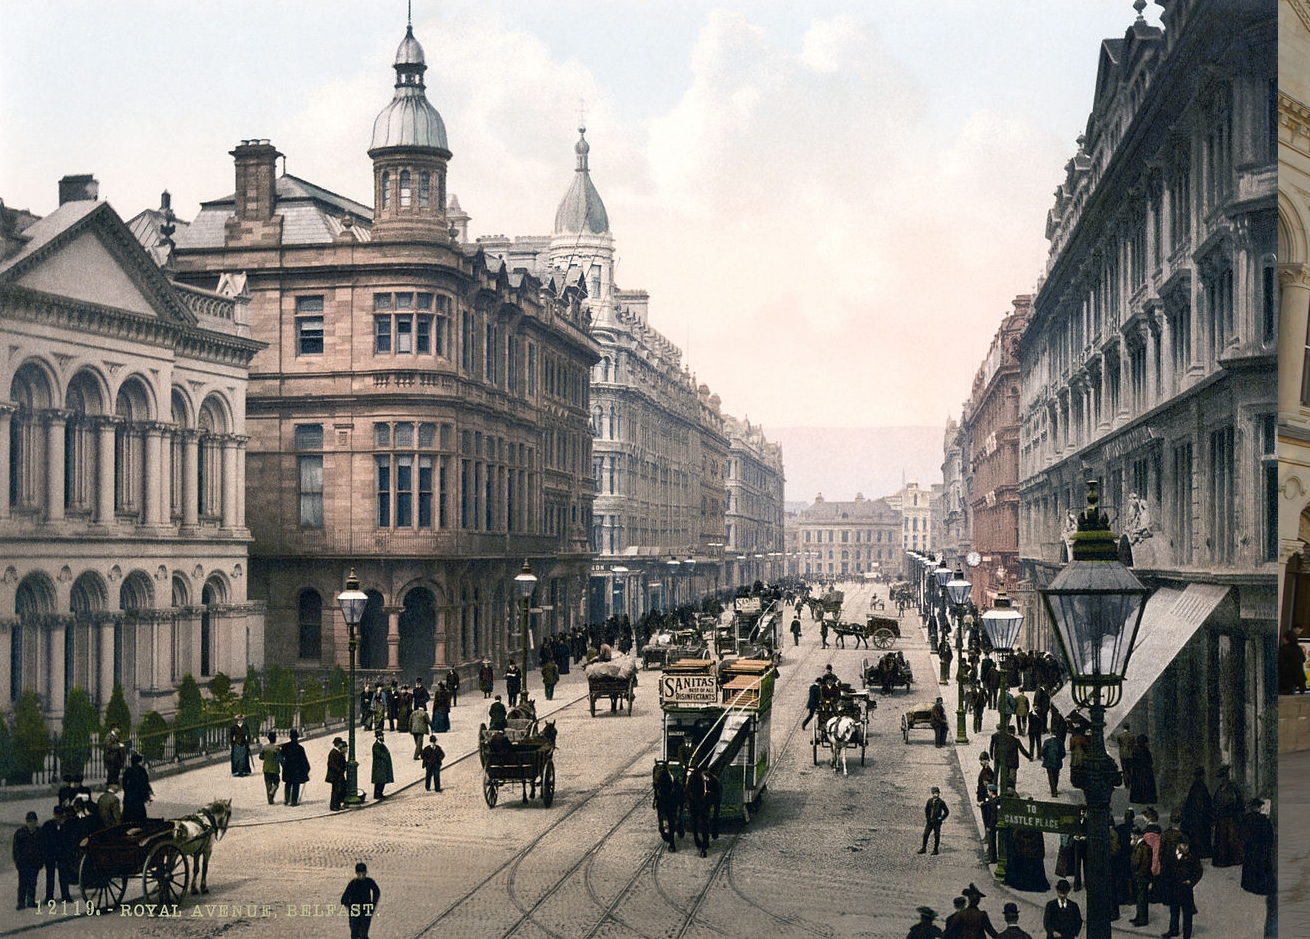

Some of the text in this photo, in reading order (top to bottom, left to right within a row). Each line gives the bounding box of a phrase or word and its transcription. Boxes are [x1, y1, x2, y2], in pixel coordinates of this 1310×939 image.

[665, 678, 714, 697] SANITAS
[675, 693, 716, 701] DISINFECTANTS
[1026, 804, 1037, 814] TO
[1004, 815, 1060, 829] CASTLE PLACE
